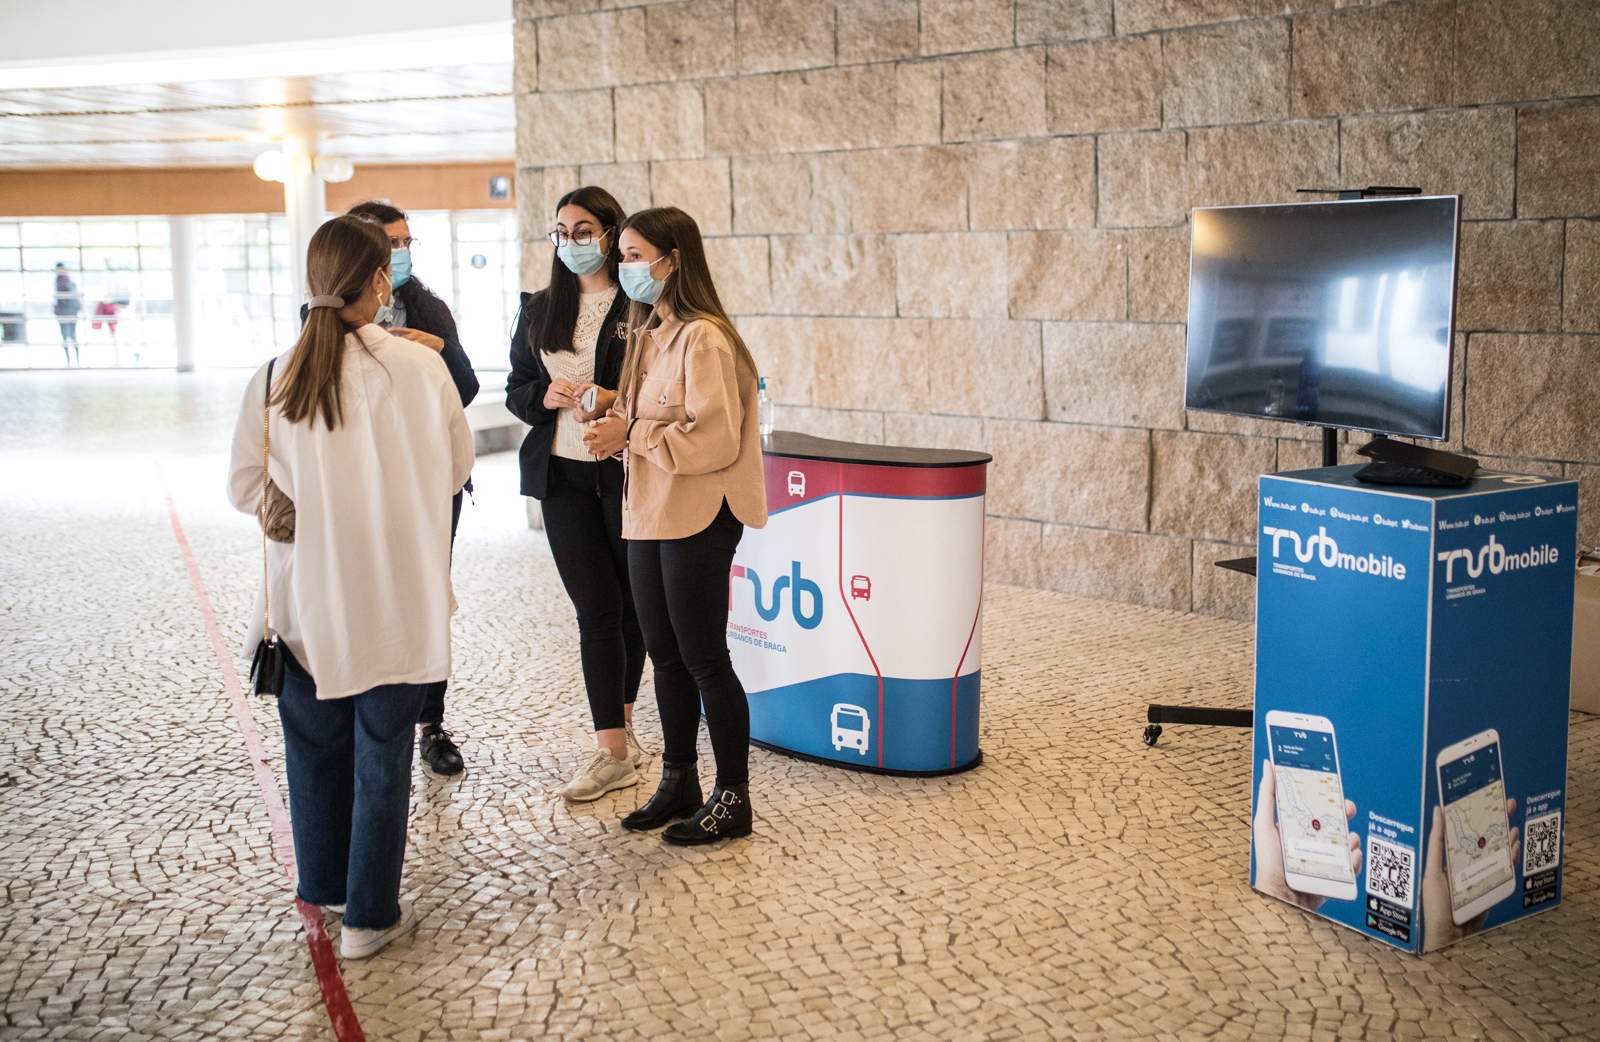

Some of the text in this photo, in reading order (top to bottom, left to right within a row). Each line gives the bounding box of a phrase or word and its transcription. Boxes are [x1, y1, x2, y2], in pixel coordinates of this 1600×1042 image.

[727, 622, 768, 640] TRANSPORTES
[754, 638, 763, 647] DE
[763, 641, 787, 653] BRAGA
[1526, 789, 1561, 804] Descarregue
[1538, 803, 1548, 812] app
[1369, 810, 1415, 834] Descarregue
[1383, 827, 1397, 839] app
[1380, 906, 1408, 923] App Store
[1378, 922, 1408, 941] Google Play
